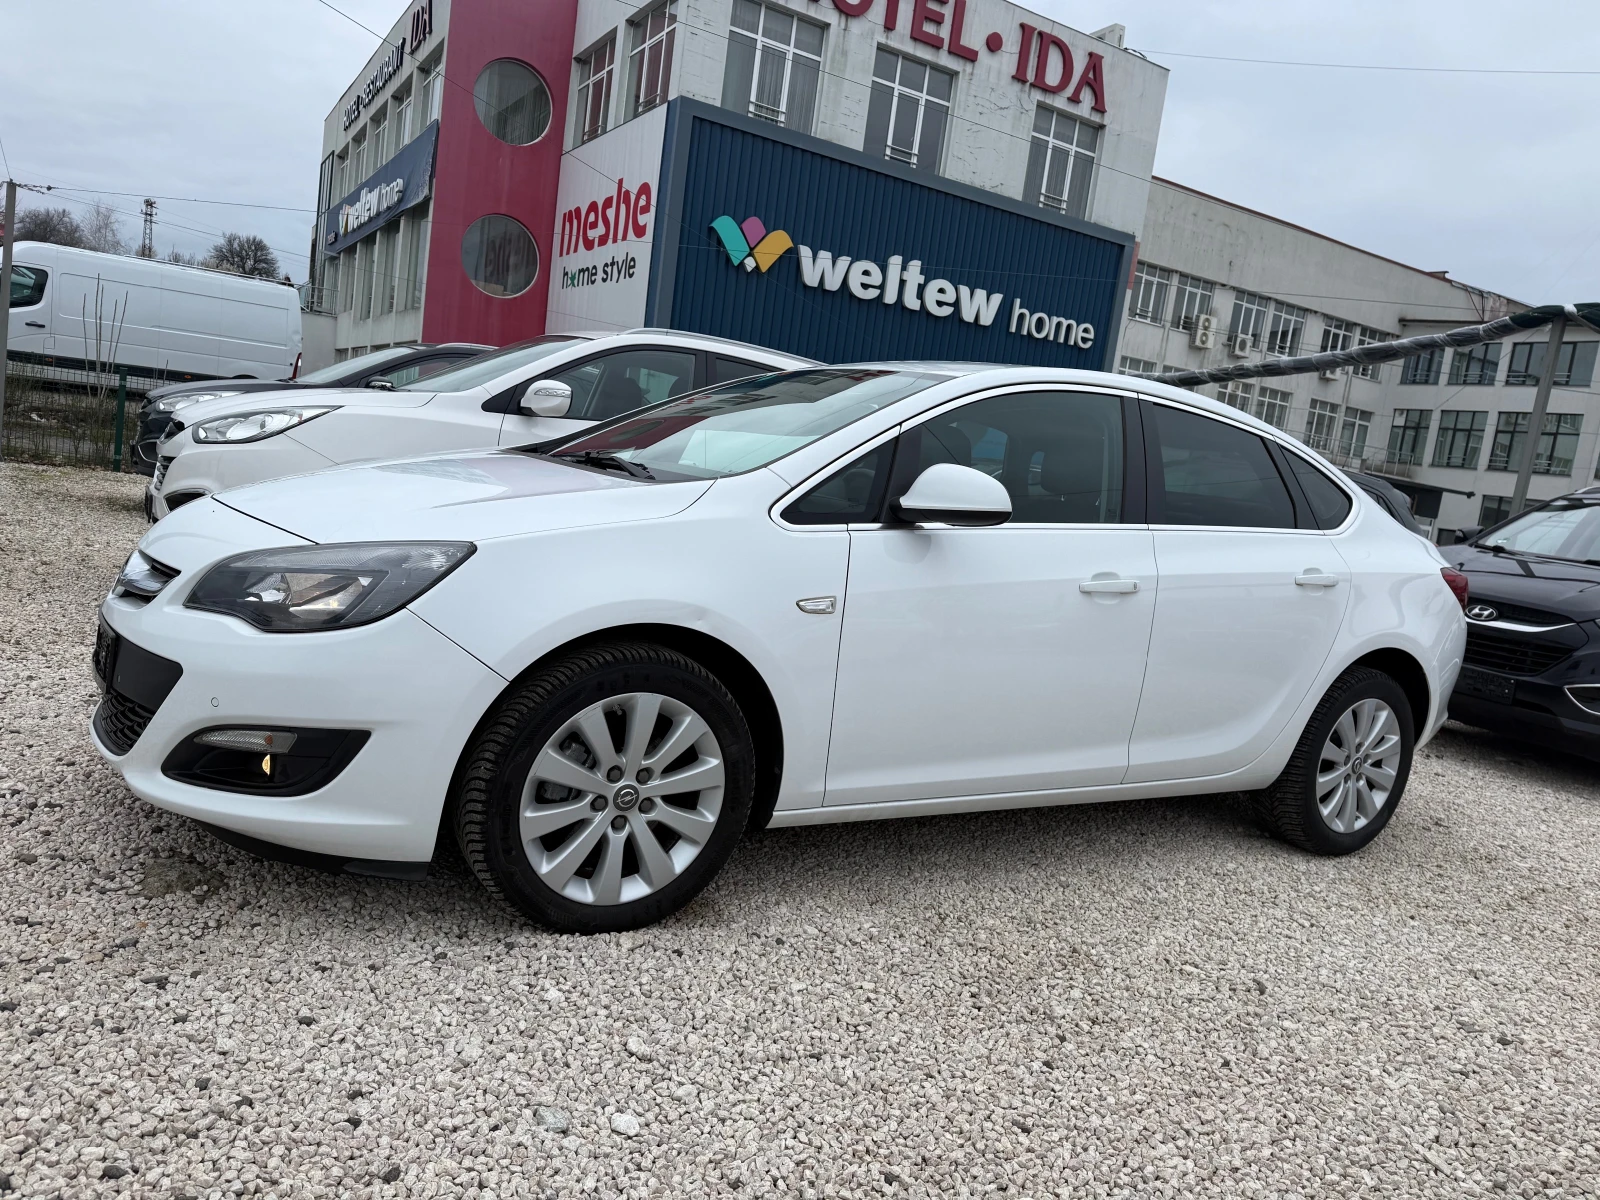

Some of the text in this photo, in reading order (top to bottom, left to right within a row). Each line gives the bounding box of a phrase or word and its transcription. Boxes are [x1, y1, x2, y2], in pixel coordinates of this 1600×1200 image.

[1011, 22, 1107, 113] IDA
[559, 177, 652, 258] meshe
[561, 251, 637, 292] hme style
[797, 244, 1095, 349] weltew home
